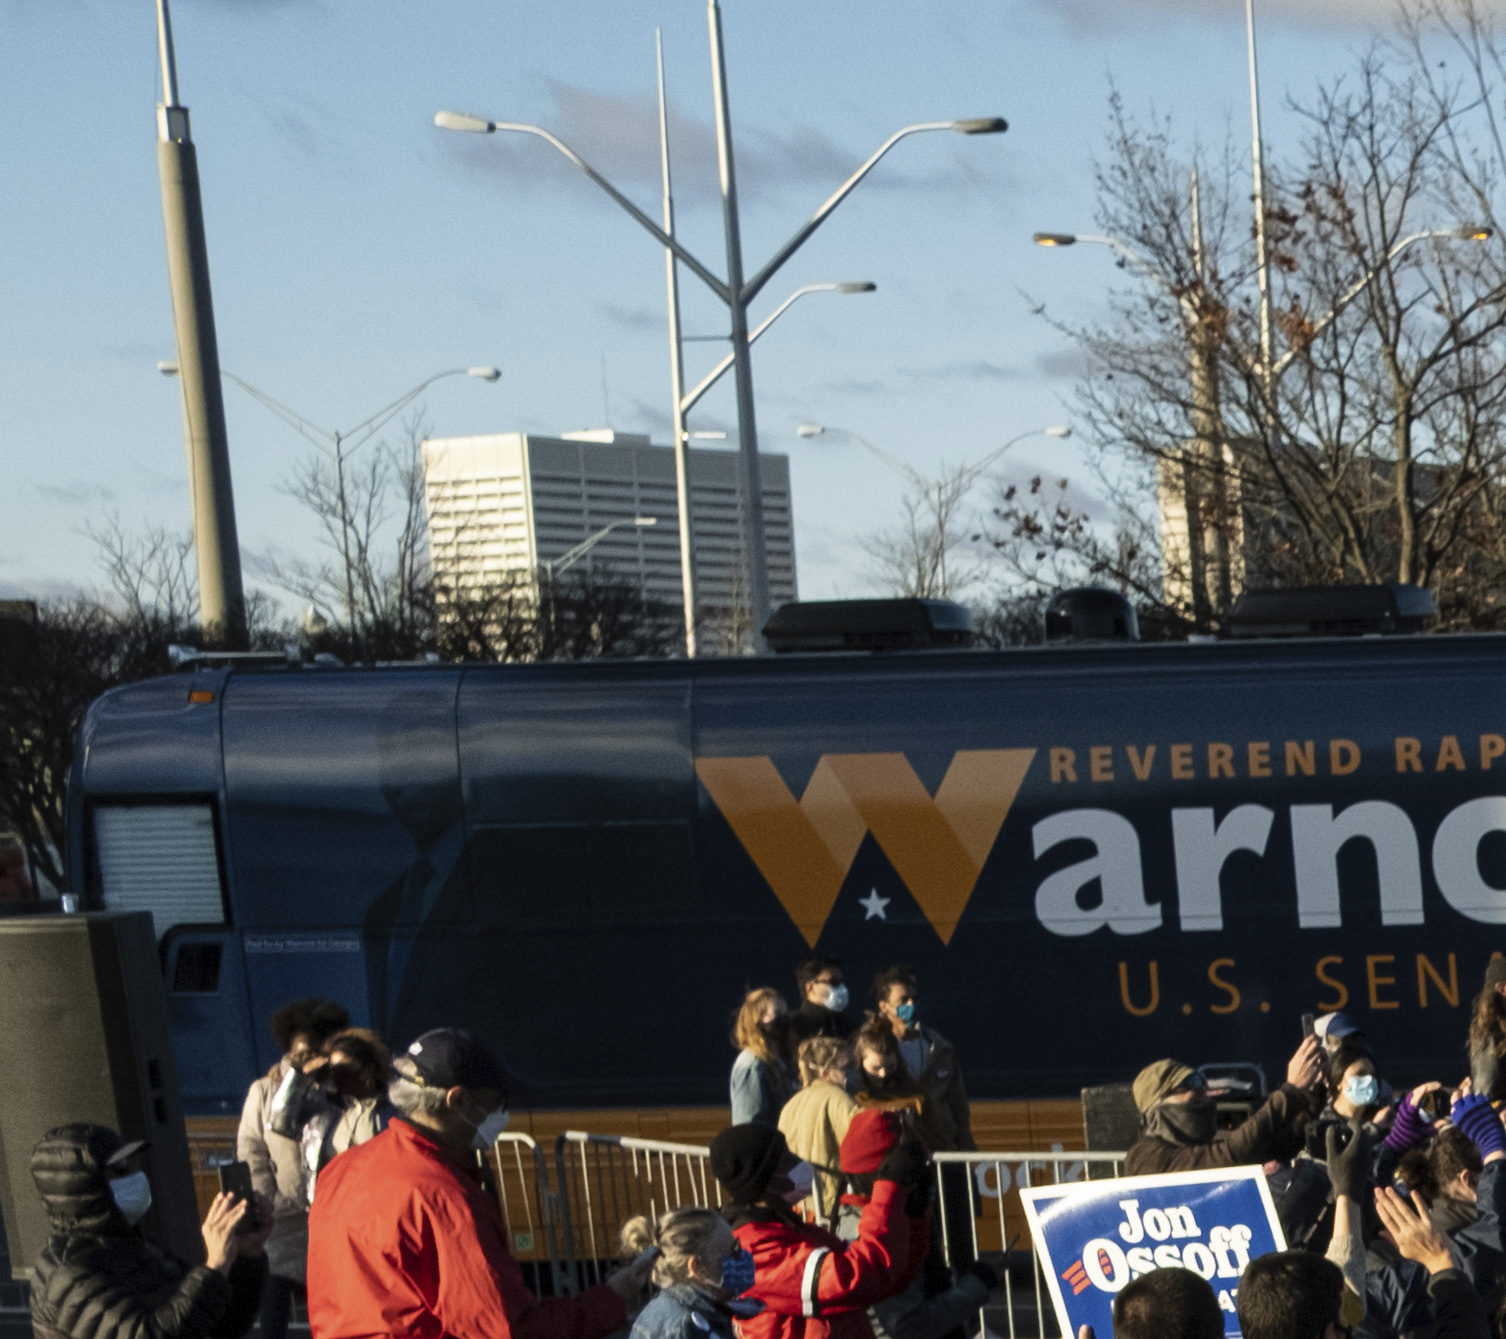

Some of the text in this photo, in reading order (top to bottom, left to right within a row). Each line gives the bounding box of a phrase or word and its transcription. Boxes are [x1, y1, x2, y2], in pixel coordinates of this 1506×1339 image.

[1050, 738, 1361, 784] REVEREND
[1118, 958, 1272, 1016] U.S.
[1118, 1199, 1202, 1243] Jon
[1082, 1224, 1253, 1293] Ossoff
